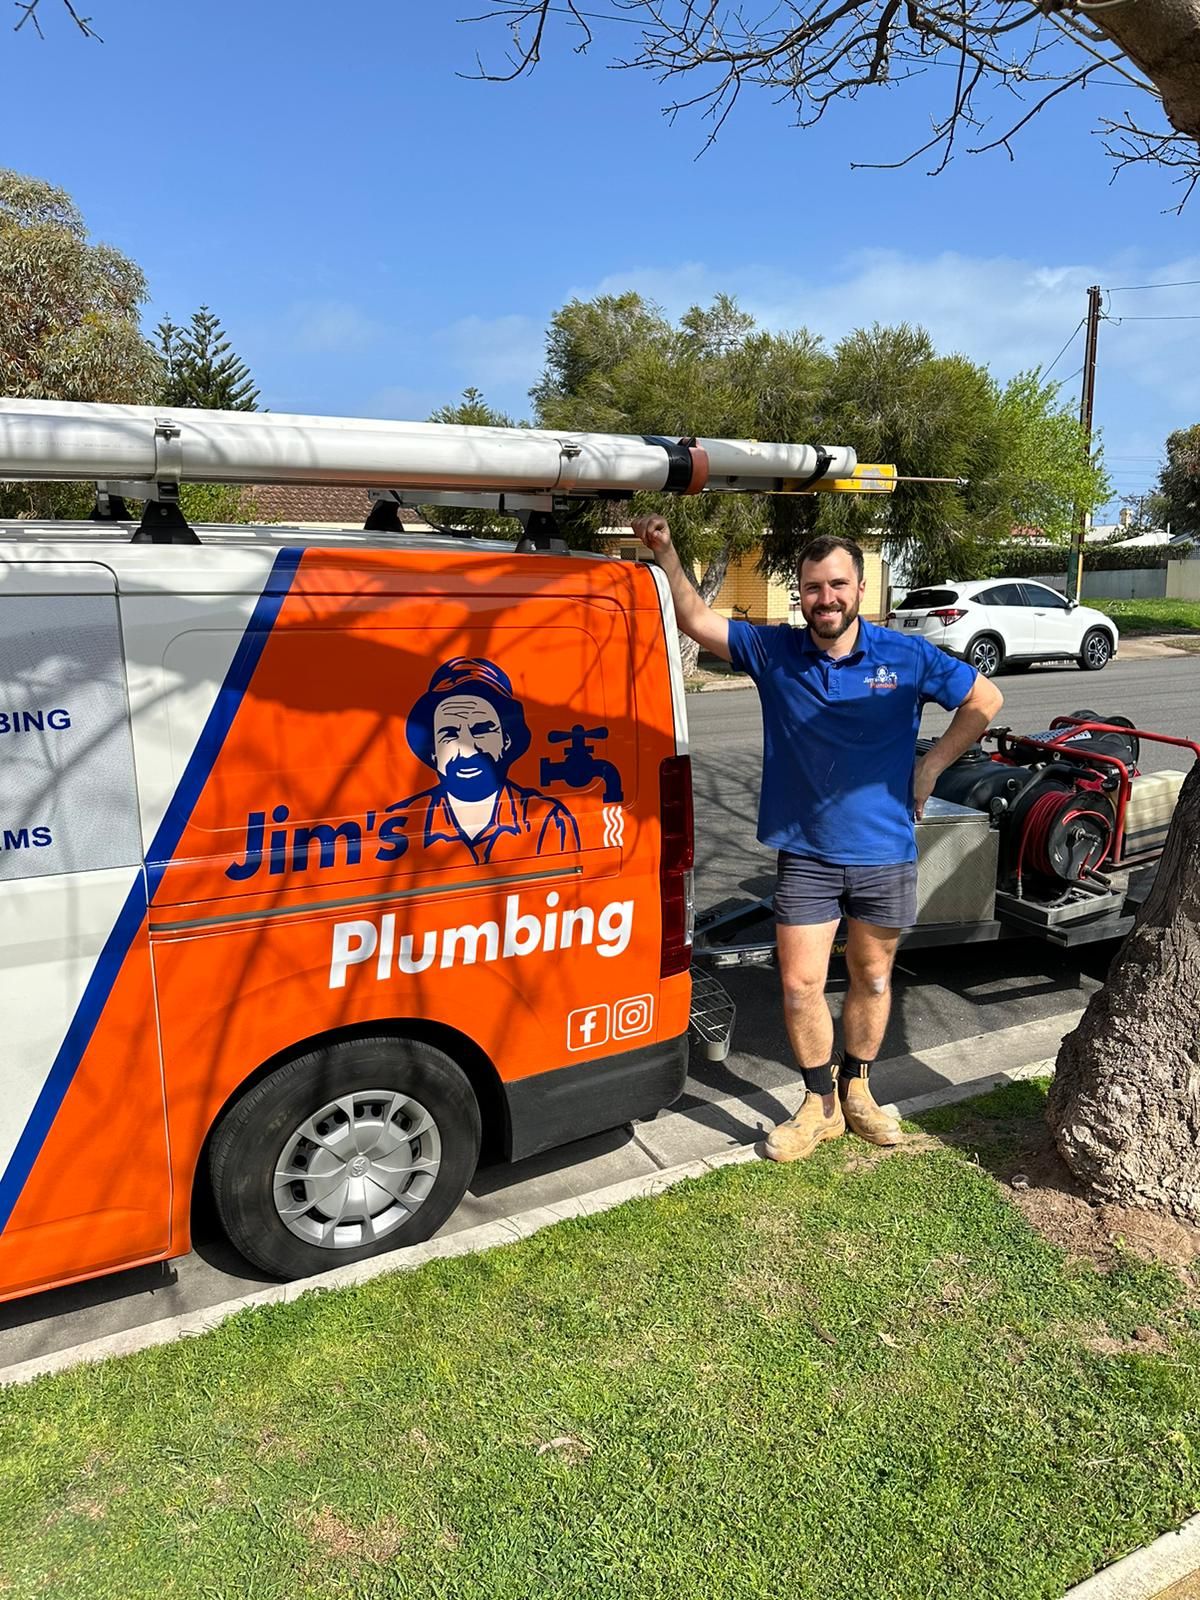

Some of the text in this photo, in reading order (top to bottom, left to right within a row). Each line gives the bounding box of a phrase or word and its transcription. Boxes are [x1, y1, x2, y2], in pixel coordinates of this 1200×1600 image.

[0, 827, 52, 850] MS
[225, 805, 409, 881] Jim's
[329, 891, 634, 989] Plumbing
